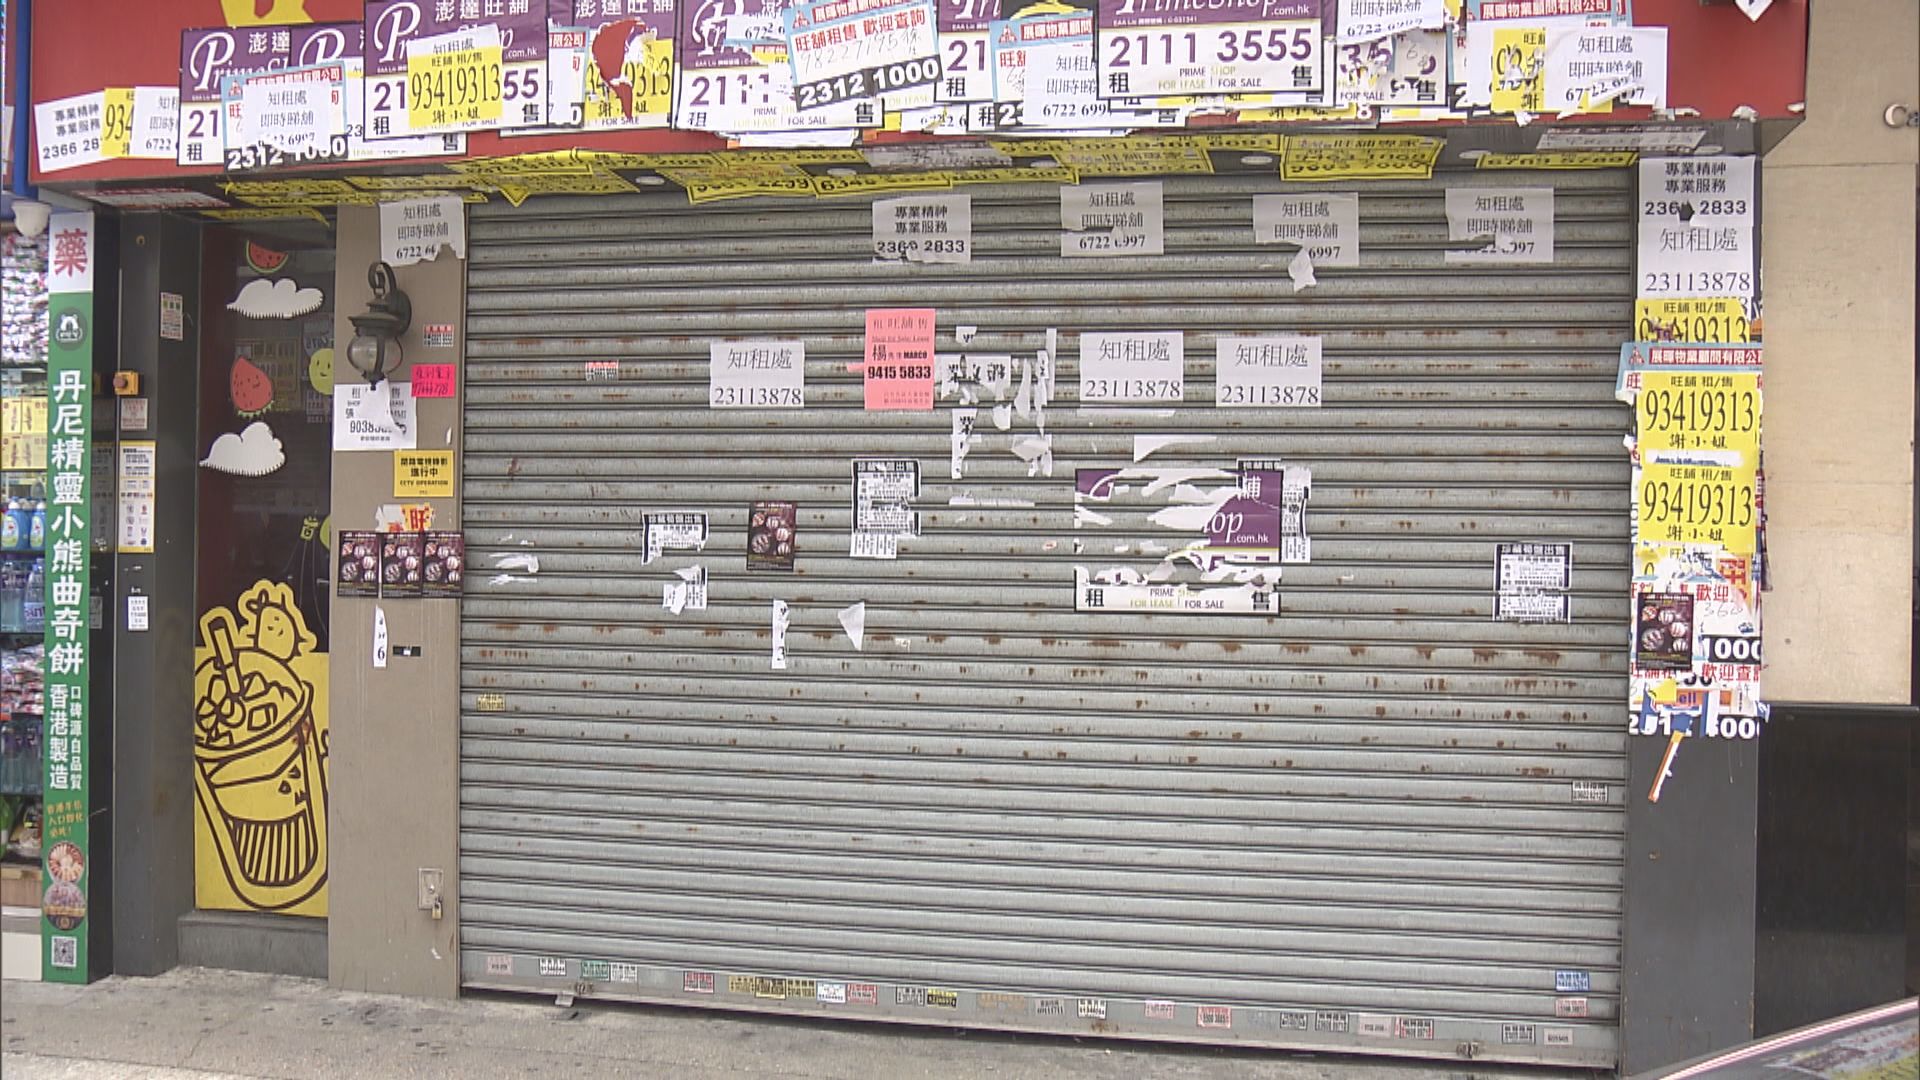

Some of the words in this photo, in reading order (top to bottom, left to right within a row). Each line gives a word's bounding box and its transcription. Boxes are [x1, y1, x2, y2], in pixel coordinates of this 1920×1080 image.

[1109, 33, 1198, 67] 2111
[1216, 28, 1312, 63] 3555
[1577, 35, 1634, 54] 知租處
[1179, 67, 1206, 78] PRIME
[1290, 66, 1312, 87] 售
[411, 63, 501, 112] 93419313
[799, 73, 865, 108] 2312
[872, 59, 939, 90] 1000
[946, 76, 966, 98] 租
[1109, 72, 1130, 94] 租
[1218, 78, 1237, 89] FOR
[1240, 77, 1262, 88] SALE
[521, 103, 539, 123] 售
[788, 117, 804, 126] FOR
[808, 116, 827, 125] SALE
[854, 102, 874, 123] 售
[1043, 104, 1077, 118] 6722
[373, 115, 390, 135] 租
[43, 142, 77, 160] 2366
[186, 142, 203, 162] 租
[1665, 161, 1727, 176] 專業精神
[1665, 177, 1727, 194] 專業服務
[1088, 191, 1136, 208] 知租處
[1281, 201, 1330, 218] 知租處
[1475, 195, 1525, 212] 知租處
[1699, 200, 1747, 216] 2833
[924, 240, 966, 253] 2833
[1079, 235, 1110, 250] 6722
[1659, 227, 1739, 253] 知租處
[54, 228, 88, 277] 藥
[396, 245, 422, 260] 6722
[1644, 271, 1751, 293] 23113878
[727, 347, 793, 370] 知租處
[903, 351, 928, 359] MARCO
[1099, 339, 1170, 362] 知租處
[1234, 343, 1309, 368] 知租處
[868, 365, 897, 380] 9415
[899, 365, 931, 380] 5833
[714, 386, 802, 406] 23113878
[1085, 379, 1180, 399] 23113878
[1221, 384, 1319, 405] 23113878
[1645, 389, 1754, 432] 93419313
[1643, 480, 1752, 527] 93419313
[48, 368, 87, 676] 丹尼精靈小熊曲奇餅
[1233, 533, 1269, 544] .com.hk
[1085, 588, 1104, 607] 租
[1150, 588, 1174, 598] PRIME
[1184, 599, 1202, 609] FOR
[1205, 599, 1224, 609] SALE
[49, 683, 69, 790] 香港製造
[69, 685, 83, 791] 口碑源自品質
